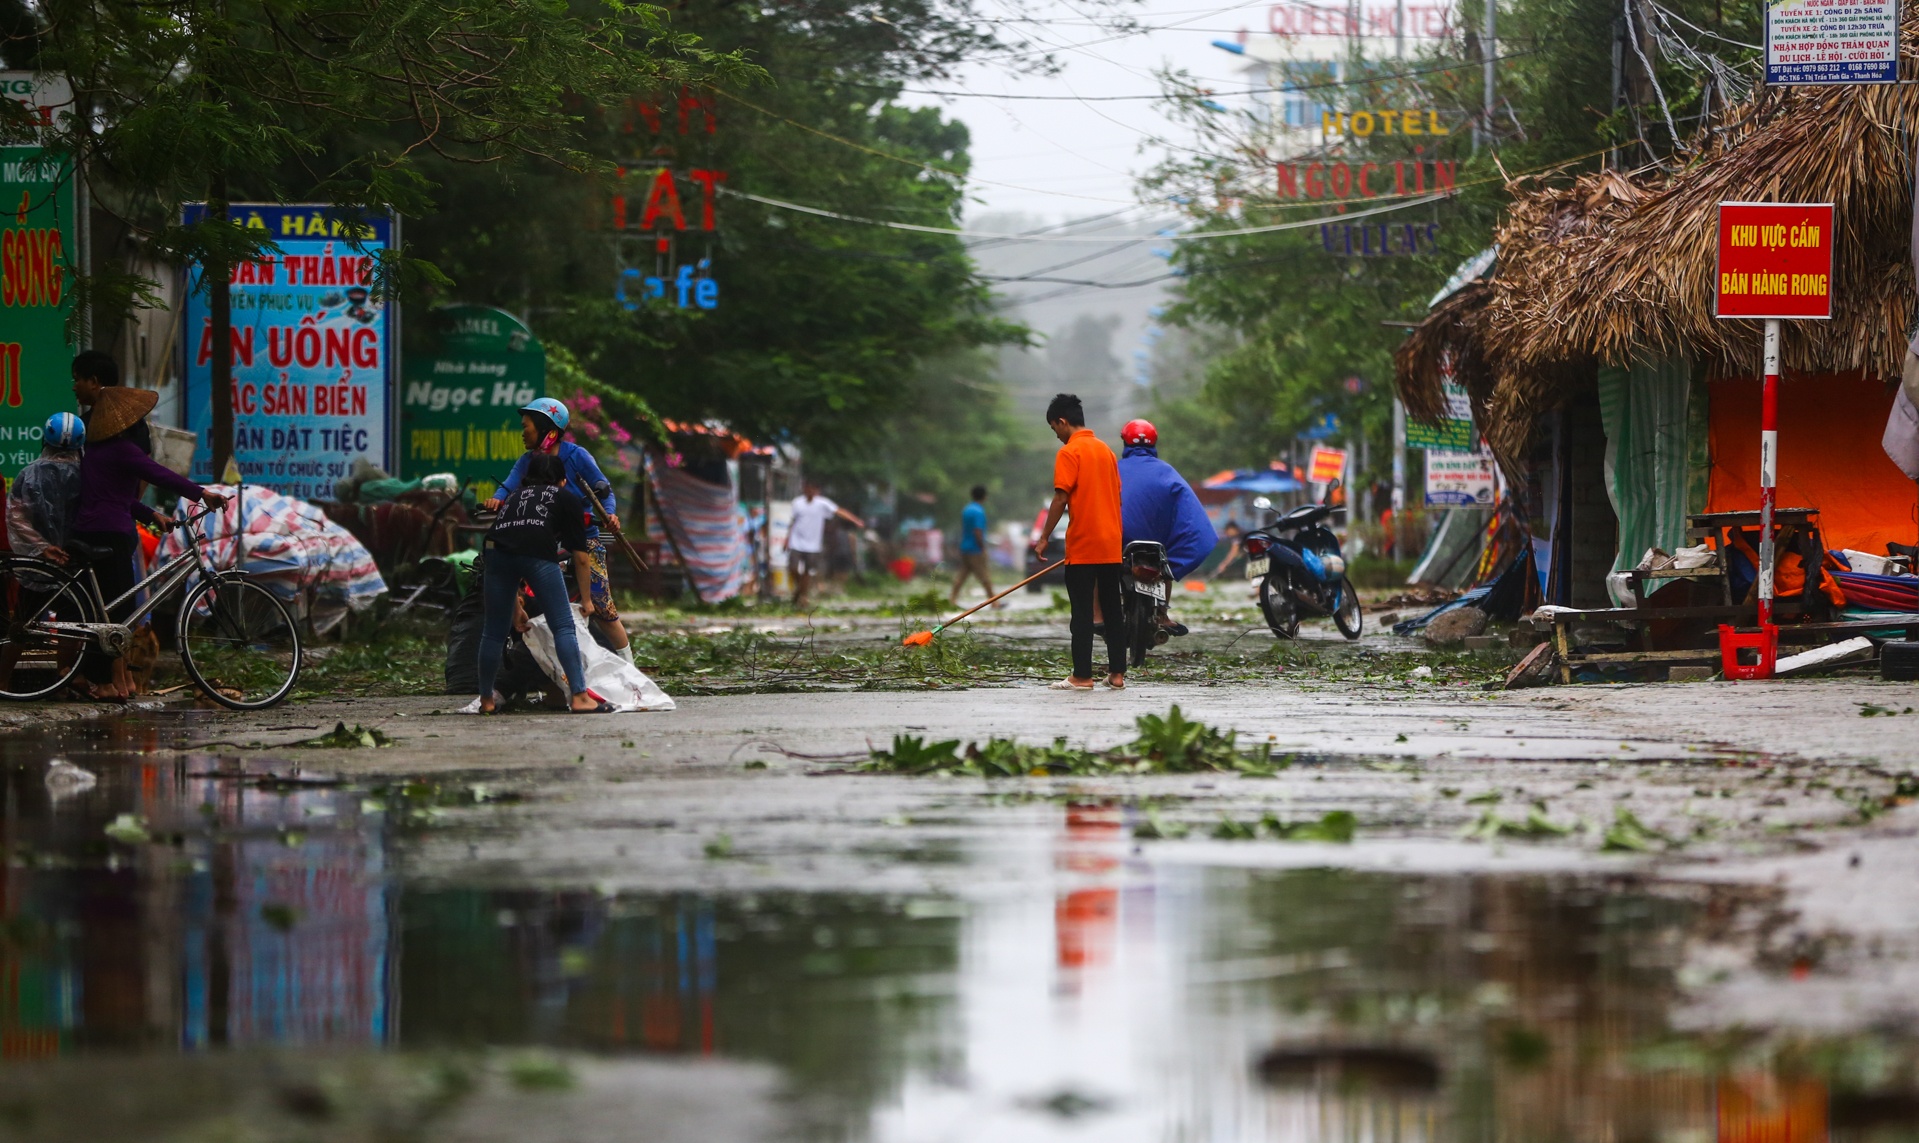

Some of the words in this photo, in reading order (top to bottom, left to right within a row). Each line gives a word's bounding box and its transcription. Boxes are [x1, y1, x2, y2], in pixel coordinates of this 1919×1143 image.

[1780, 54, 1790, 62] DU
[1792, 54, 1810, 64] LỊCH
[1866, 40, 1890, 50] QUAN
[1802, 64, 1816, 72] 0979
[1829, 64, 1840, 72] 212
[1323, 110, 1449, 136] HOTEL
[1320, 223, 1440, 256] VILLAS
[1731, 225, 1758, 247] KHU
[1761, 223, 1787, 252] VỰC
[1790, 217, 1820, 248] CẤM
[1721, 268, 1749, 295] BÁN
[1751, 268, 1788, 296] HÀNG
[1791, 274, 1828, 296] RONG
[267, 310, 378, 369] UỐNG
[262, 371, 308, 417] SẢN
[313, 369, 368, 417] BIỂN
[405, 381, 485, 413] Ngọc
[271, 424, 313, 457] ĐẶT
[319, 424, 368, 457] TIỆC
[490, 420, 526, 462] UỐN
[288, 457, 324, 478] CHỨC
[495, 522, 512, 530] LAST
